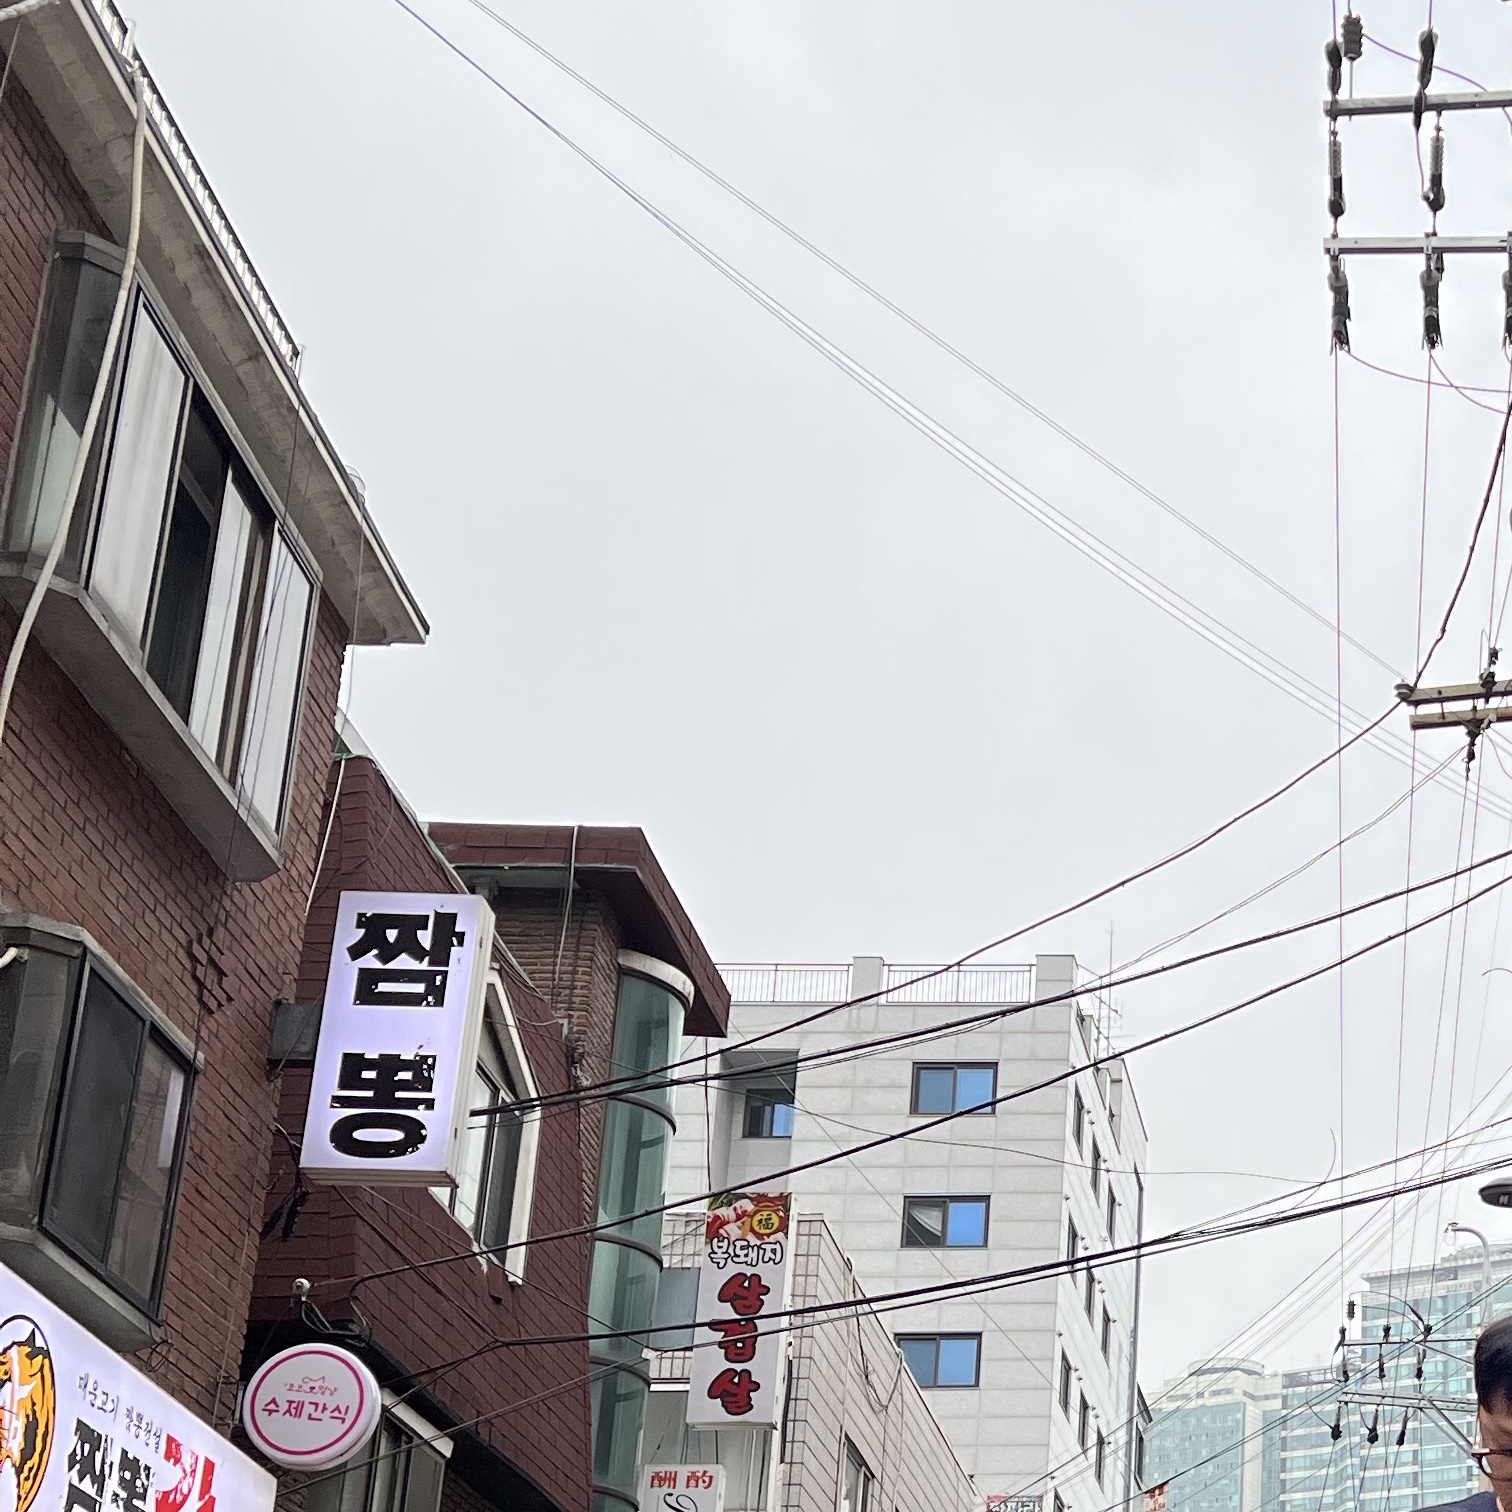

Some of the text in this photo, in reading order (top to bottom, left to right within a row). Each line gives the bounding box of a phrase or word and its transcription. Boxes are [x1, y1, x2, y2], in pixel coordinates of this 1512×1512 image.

[331, 912, 465, 1158] 짬뽕
[757, 1213, 775, 1231] 福
[709, 1237, 783, 1270] 복돼지
[707, 1272, 771, 1416] 삼겹살
[262, 1396, 350, 1425] 수제간식
